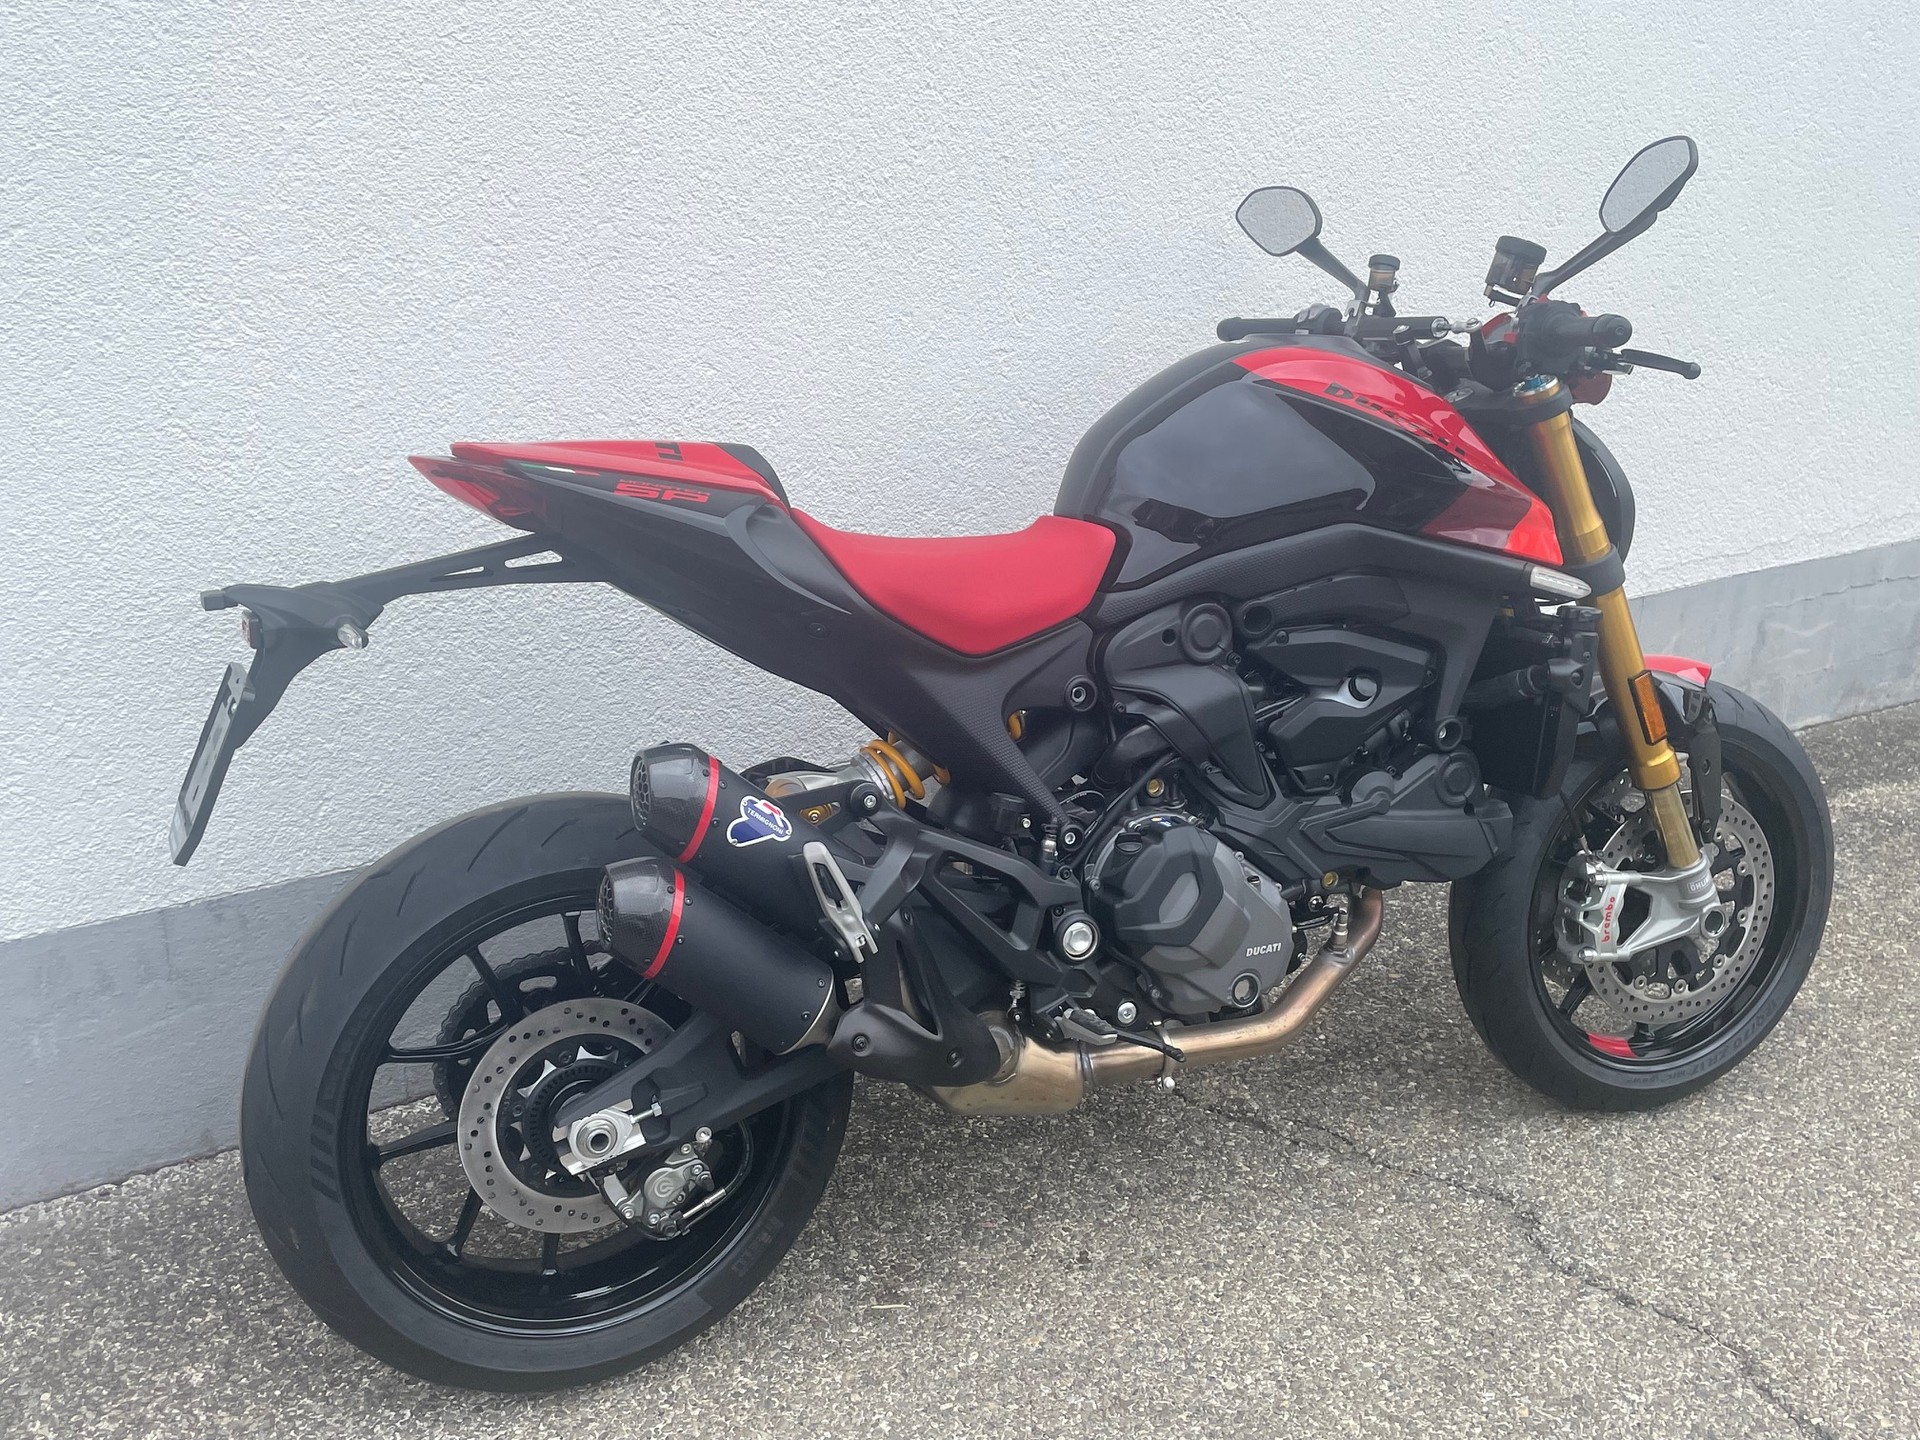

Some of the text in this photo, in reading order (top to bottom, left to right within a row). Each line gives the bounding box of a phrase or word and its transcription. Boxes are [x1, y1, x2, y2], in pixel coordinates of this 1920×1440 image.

[613, 482, 709, 503] SP
[747, 807, 785, 835] TERMIGNONI
[1601, 896, 1616, 943] brembo
[1246, 942, 1282, 957] DUCATI
